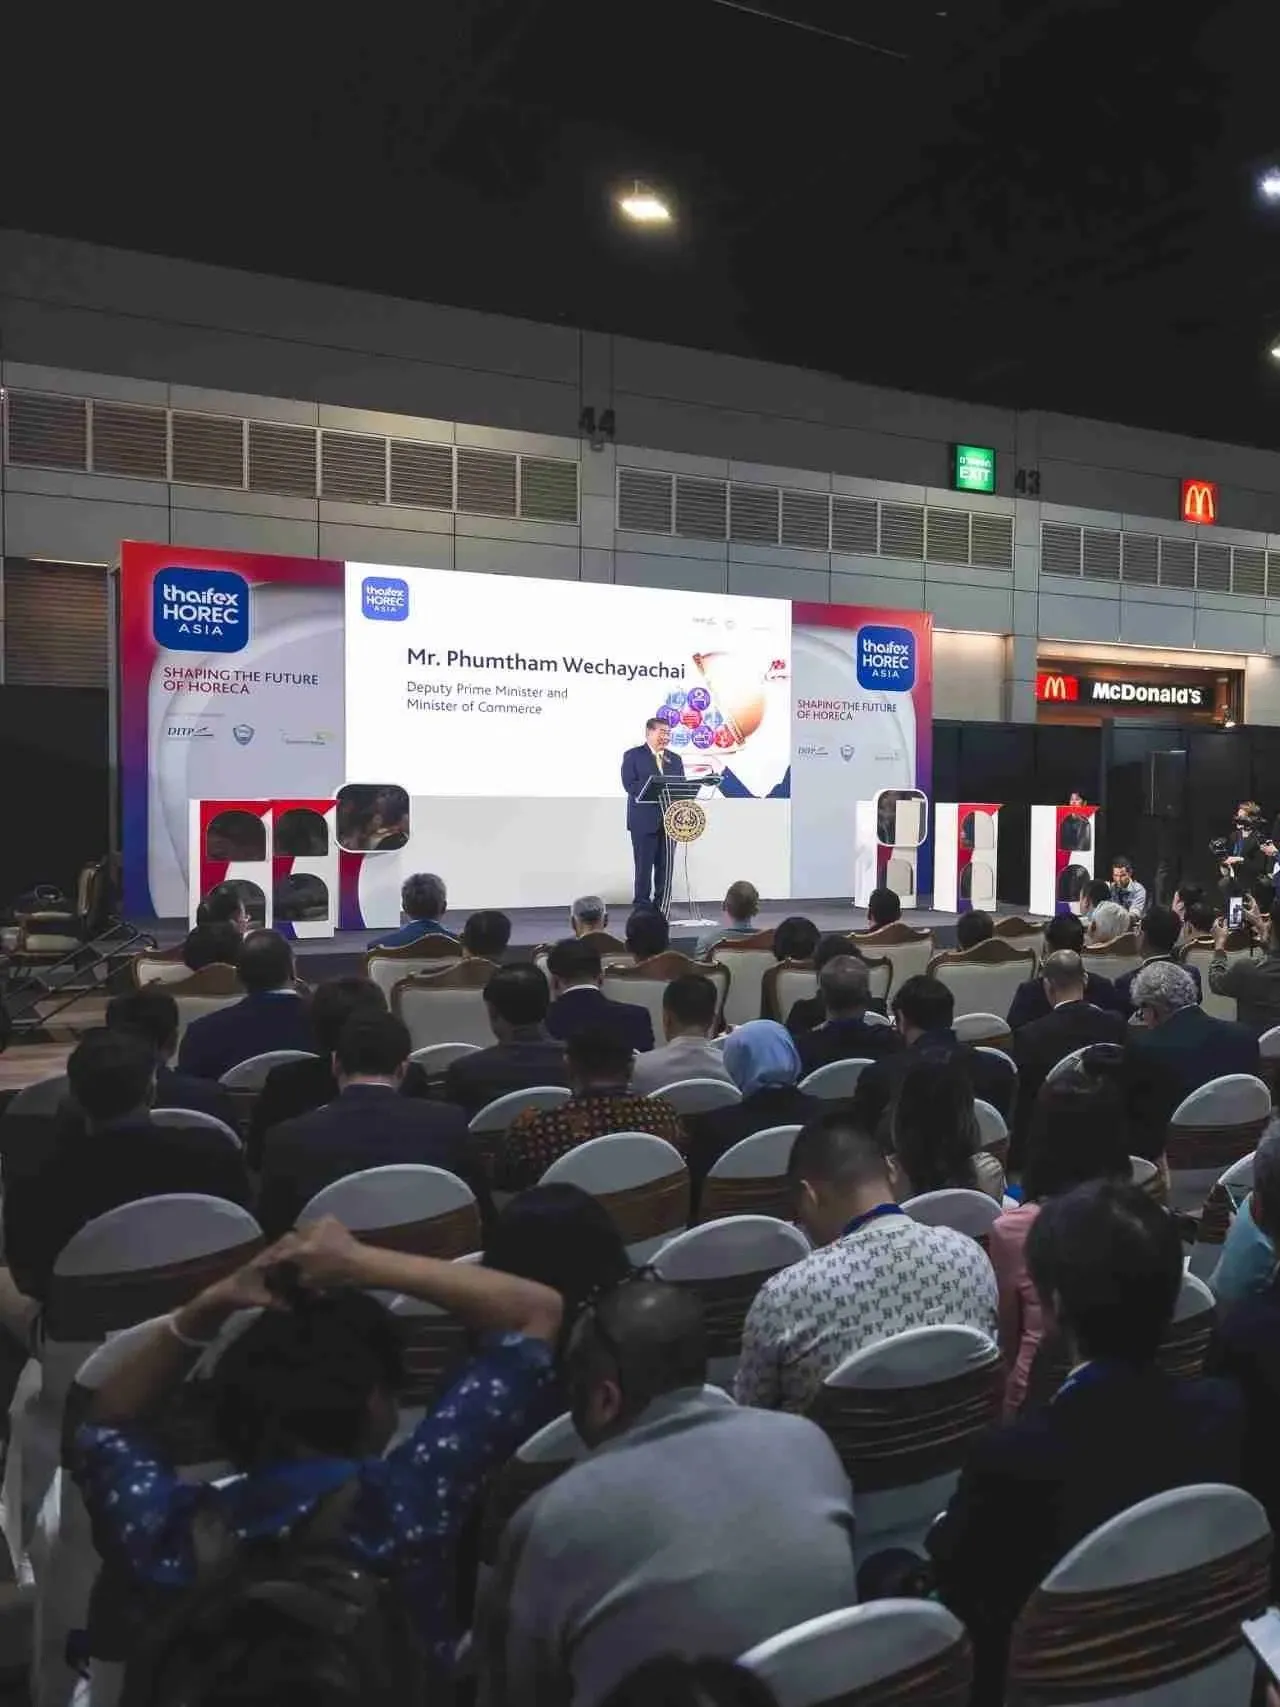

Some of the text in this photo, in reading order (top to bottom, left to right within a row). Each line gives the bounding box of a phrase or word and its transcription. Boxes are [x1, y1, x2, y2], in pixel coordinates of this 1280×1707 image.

[578, 406, 616, 436] 44
[960, 467, 992, 482] EXIT
[1015, 469, 1040, 495] 43
[163, 583, 239, 606] thaifex
[367, 596, 404, 607] HOREC
[163, 604, 239, 624] HOREC
[178, 623, 223, 636] ASIA
[862, 639, 909, 655] thaifex
[407, 648, 686, 681] Mr. Phumtham Wechayachai
[862, 654, 909, 669] HOREC
[163, 667, 319, 686] SHAPING THE FUTURE
[871, 669, 900, 678] ASIA
[163, 680, 250, 695] OF HORECA
[407, 681, 568, 699] Deputy Prime Minister and
[1092, 682, 1203, 705] McDonald's
[407, 698, 542, 715] Minister of Commerce
[798, 699, 897, 712] SHAPING THE FUTURE
[797, 710, 853, 720] OF HORECA
